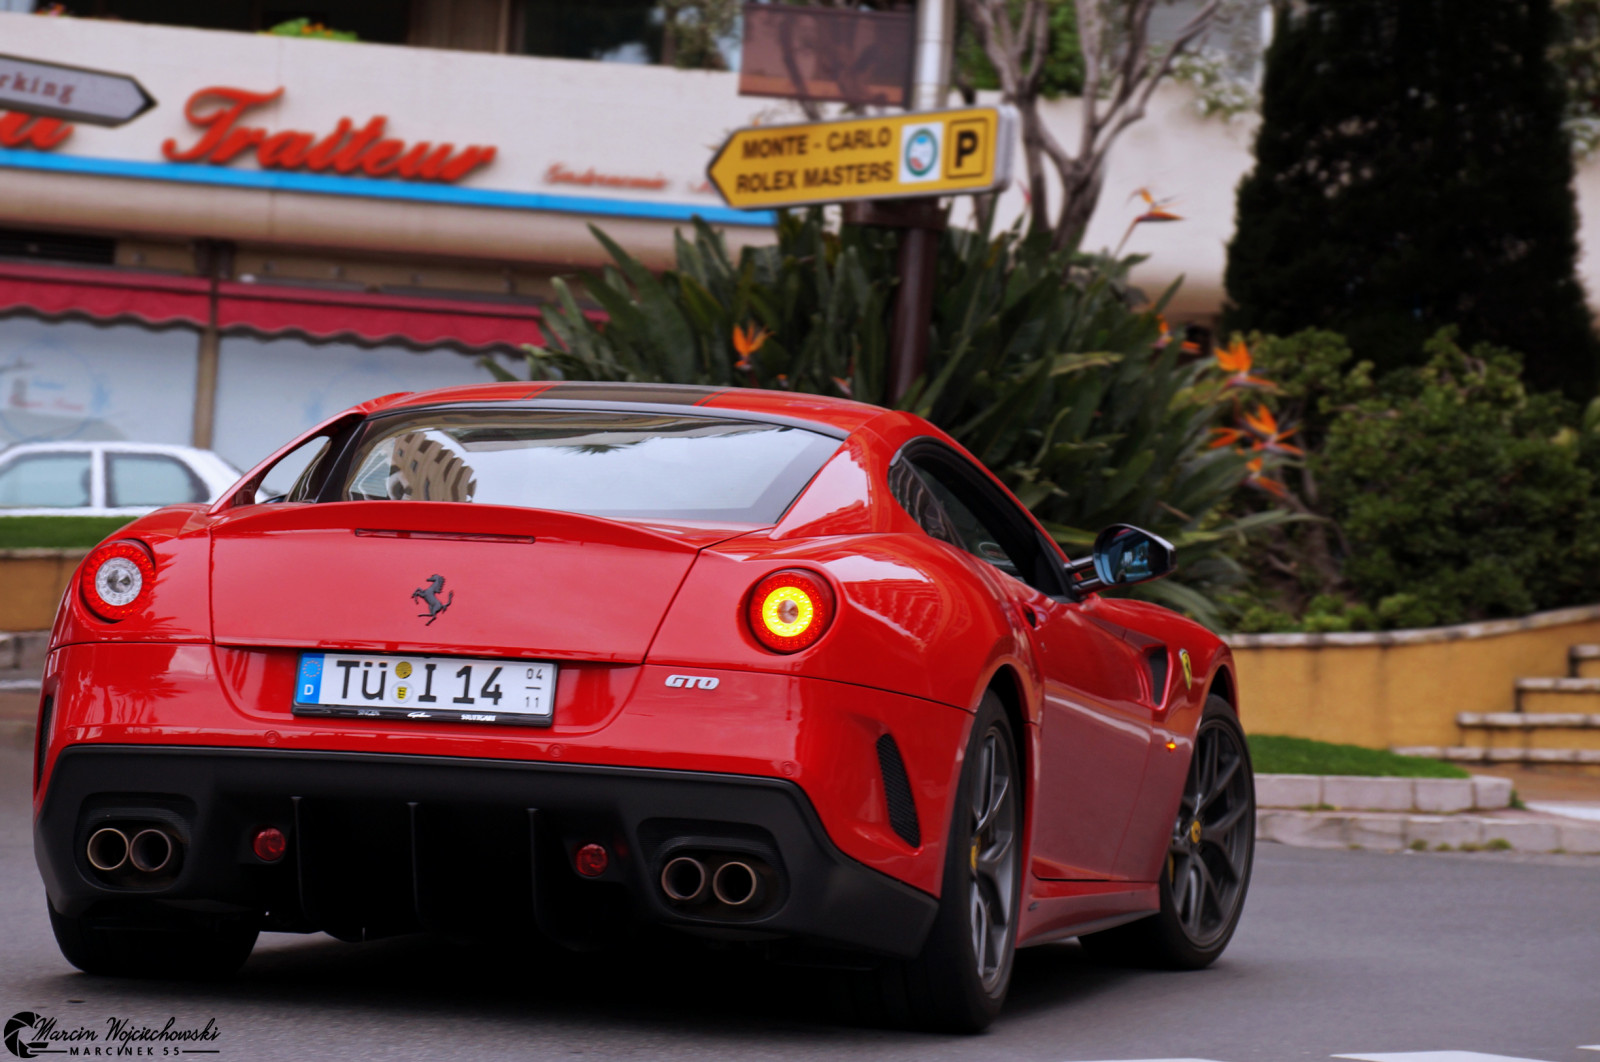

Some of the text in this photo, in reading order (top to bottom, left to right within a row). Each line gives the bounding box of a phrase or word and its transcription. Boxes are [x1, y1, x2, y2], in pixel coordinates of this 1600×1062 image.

[161, 86, 497, 181] Traiteur
[741, 135, 810, 160] MONTE
[826, 127, 892, 153] CARLO
[955, 130, 979, 169] P
[735, 170, 797, 194] ROLEX
[802, 162, 893, 188] MASTERS
[303, 684, 314, 696] D
[453, 664, 504, 706] 14
[526, 668, 544, 680] 04
[664, 674, 720, 690] GTO
[525, 696, 541, 708] 11
